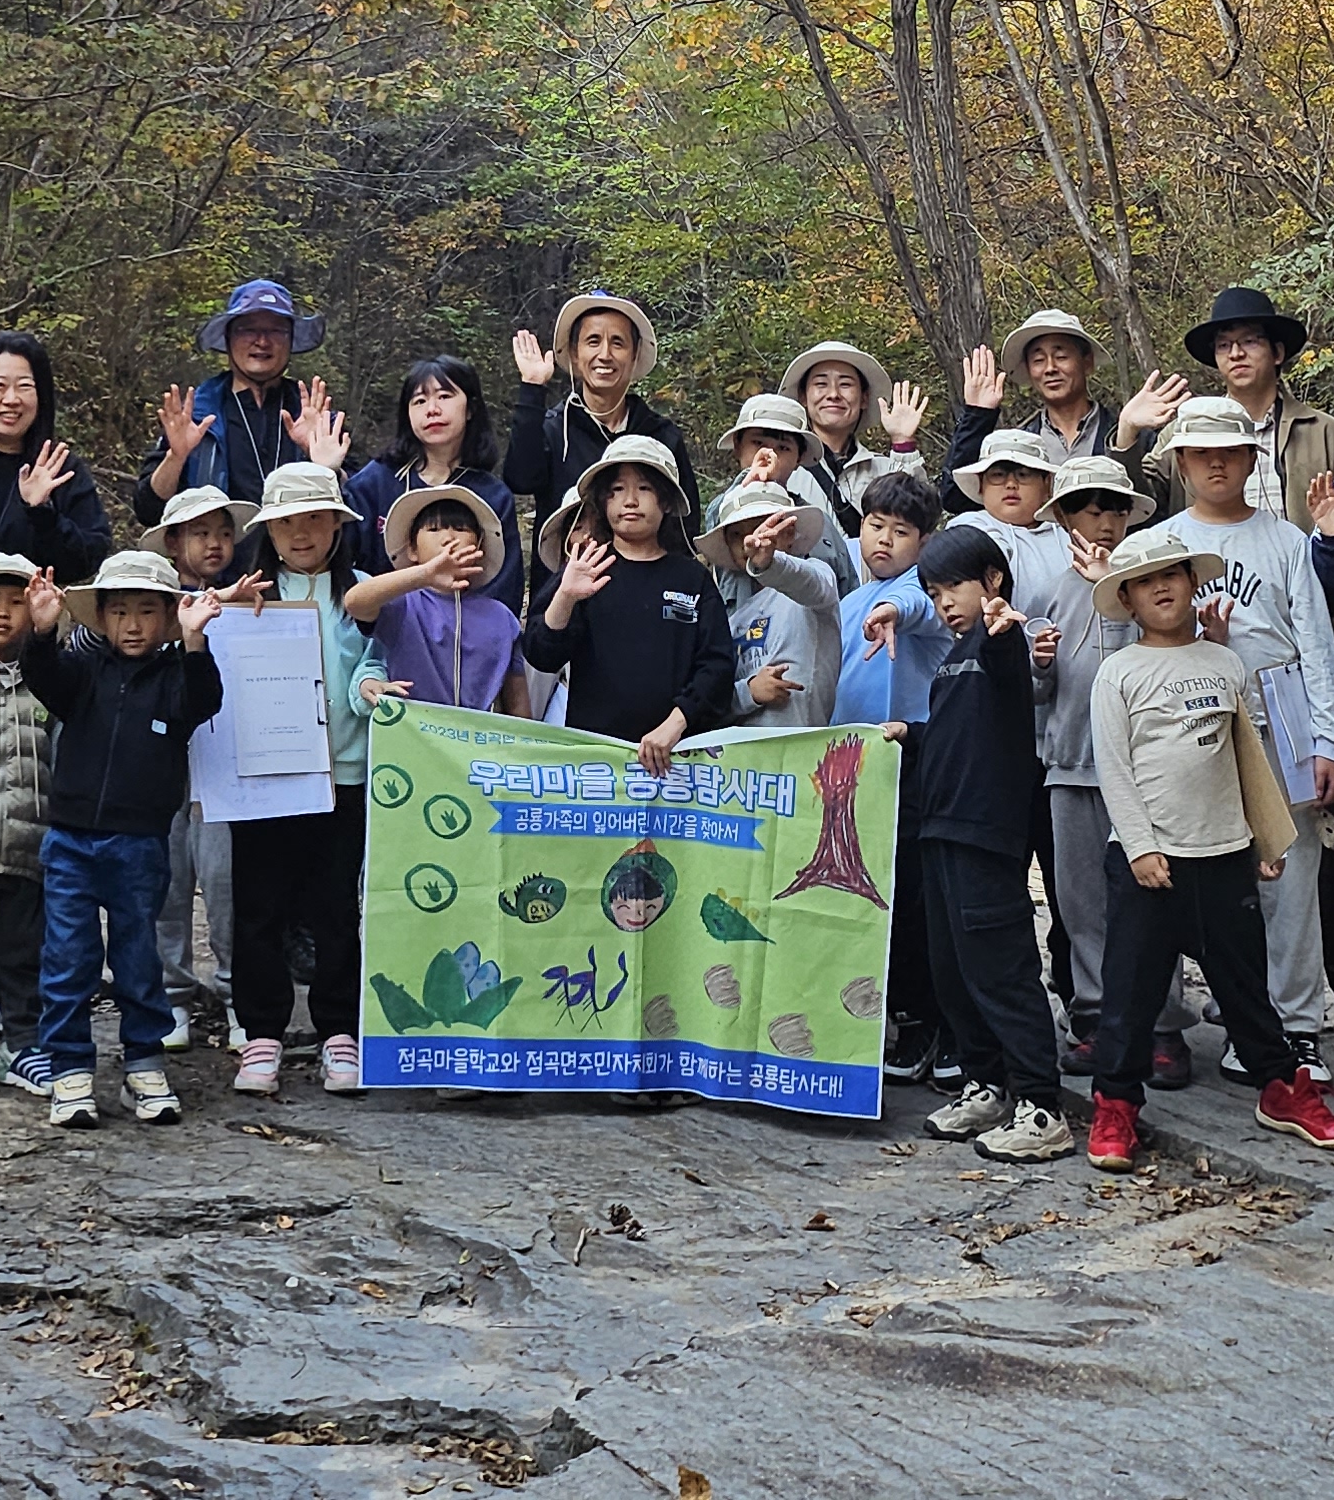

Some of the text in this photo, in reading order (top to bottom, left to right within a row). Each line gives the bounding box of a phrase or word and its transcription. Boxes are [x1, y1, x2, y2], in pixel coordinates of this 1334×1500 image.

[1162, 677, 1227, 697] NOTHING
[1187, 696, 1217, 710] SEEK
[419, 721, 469, 743] 2023년
[468, 760, 796, 817] 우리마을 공룡탐사대
[515, 807, 739, 842] 공룡가족의 잃어버린 시간을 찾아서
[398, 1048, 843, 1098] 점곡마을학교와 점곡면주민자치회가 함께하는 공룡탐사대!
